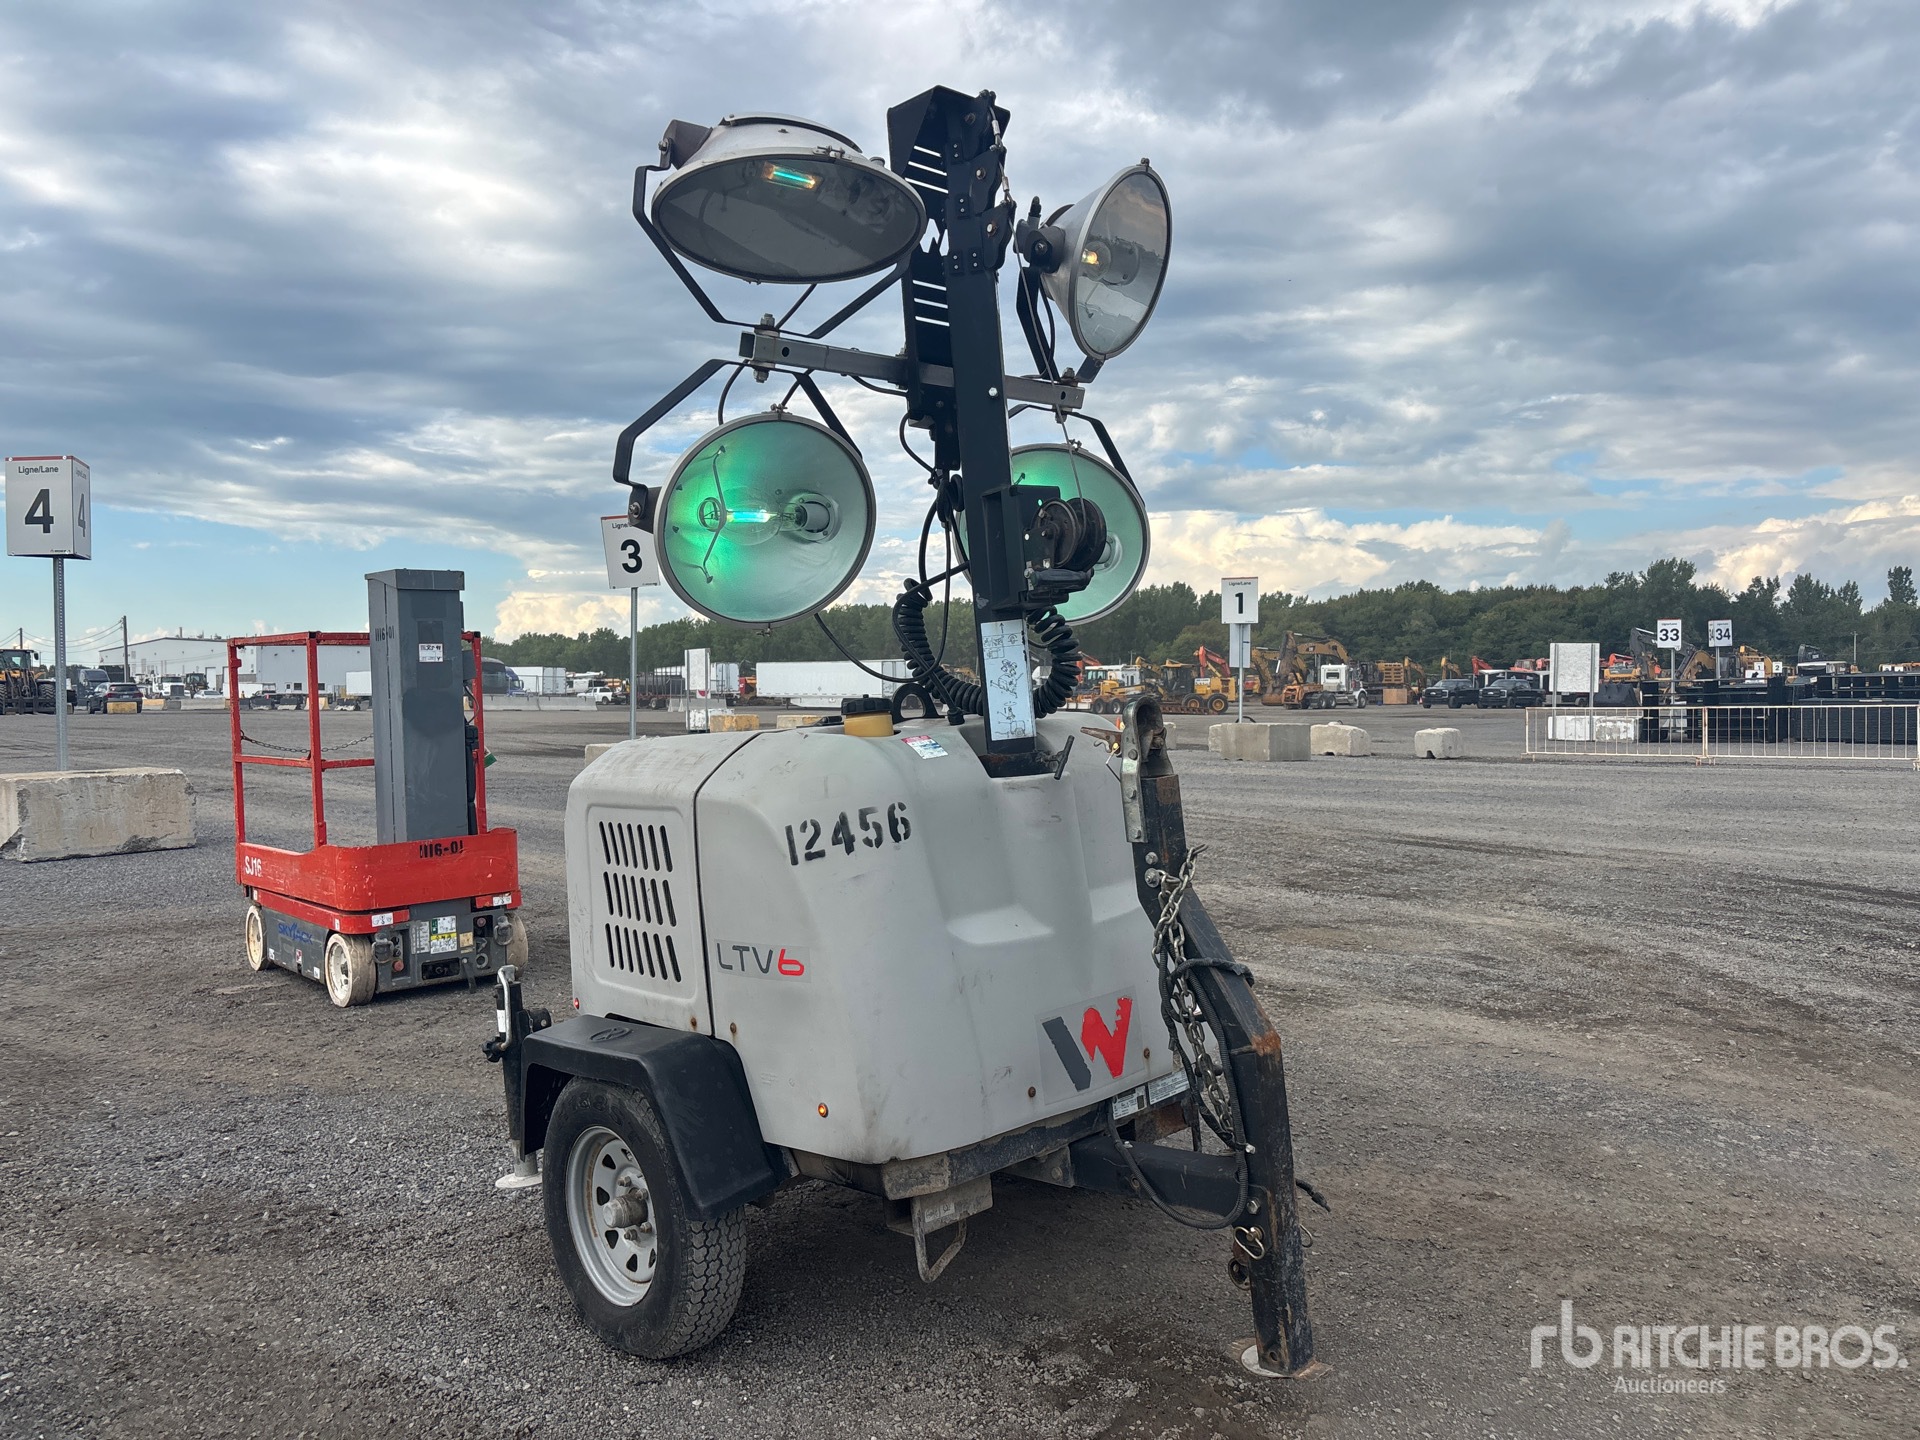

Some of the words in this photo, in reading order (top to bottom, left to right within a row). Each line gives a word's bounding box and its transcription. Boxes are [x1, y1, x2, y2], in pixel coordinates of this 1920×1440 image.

[18, 466, 59, 475] Ligne/Lane
[25, 488, 54, 534] 4
[78, 493, 86, 537] 4
[620, 539, 643, 574] 3
[1235, 592, 1243, 614] 1
[1659, 628, 1680, 642] 33
[1715, 628, 1731, 641] 34
[785, 802, 912, 866] 12456
[244, 855, 263, 877] SJ16
[716, 942, 805, 977] LTV6
